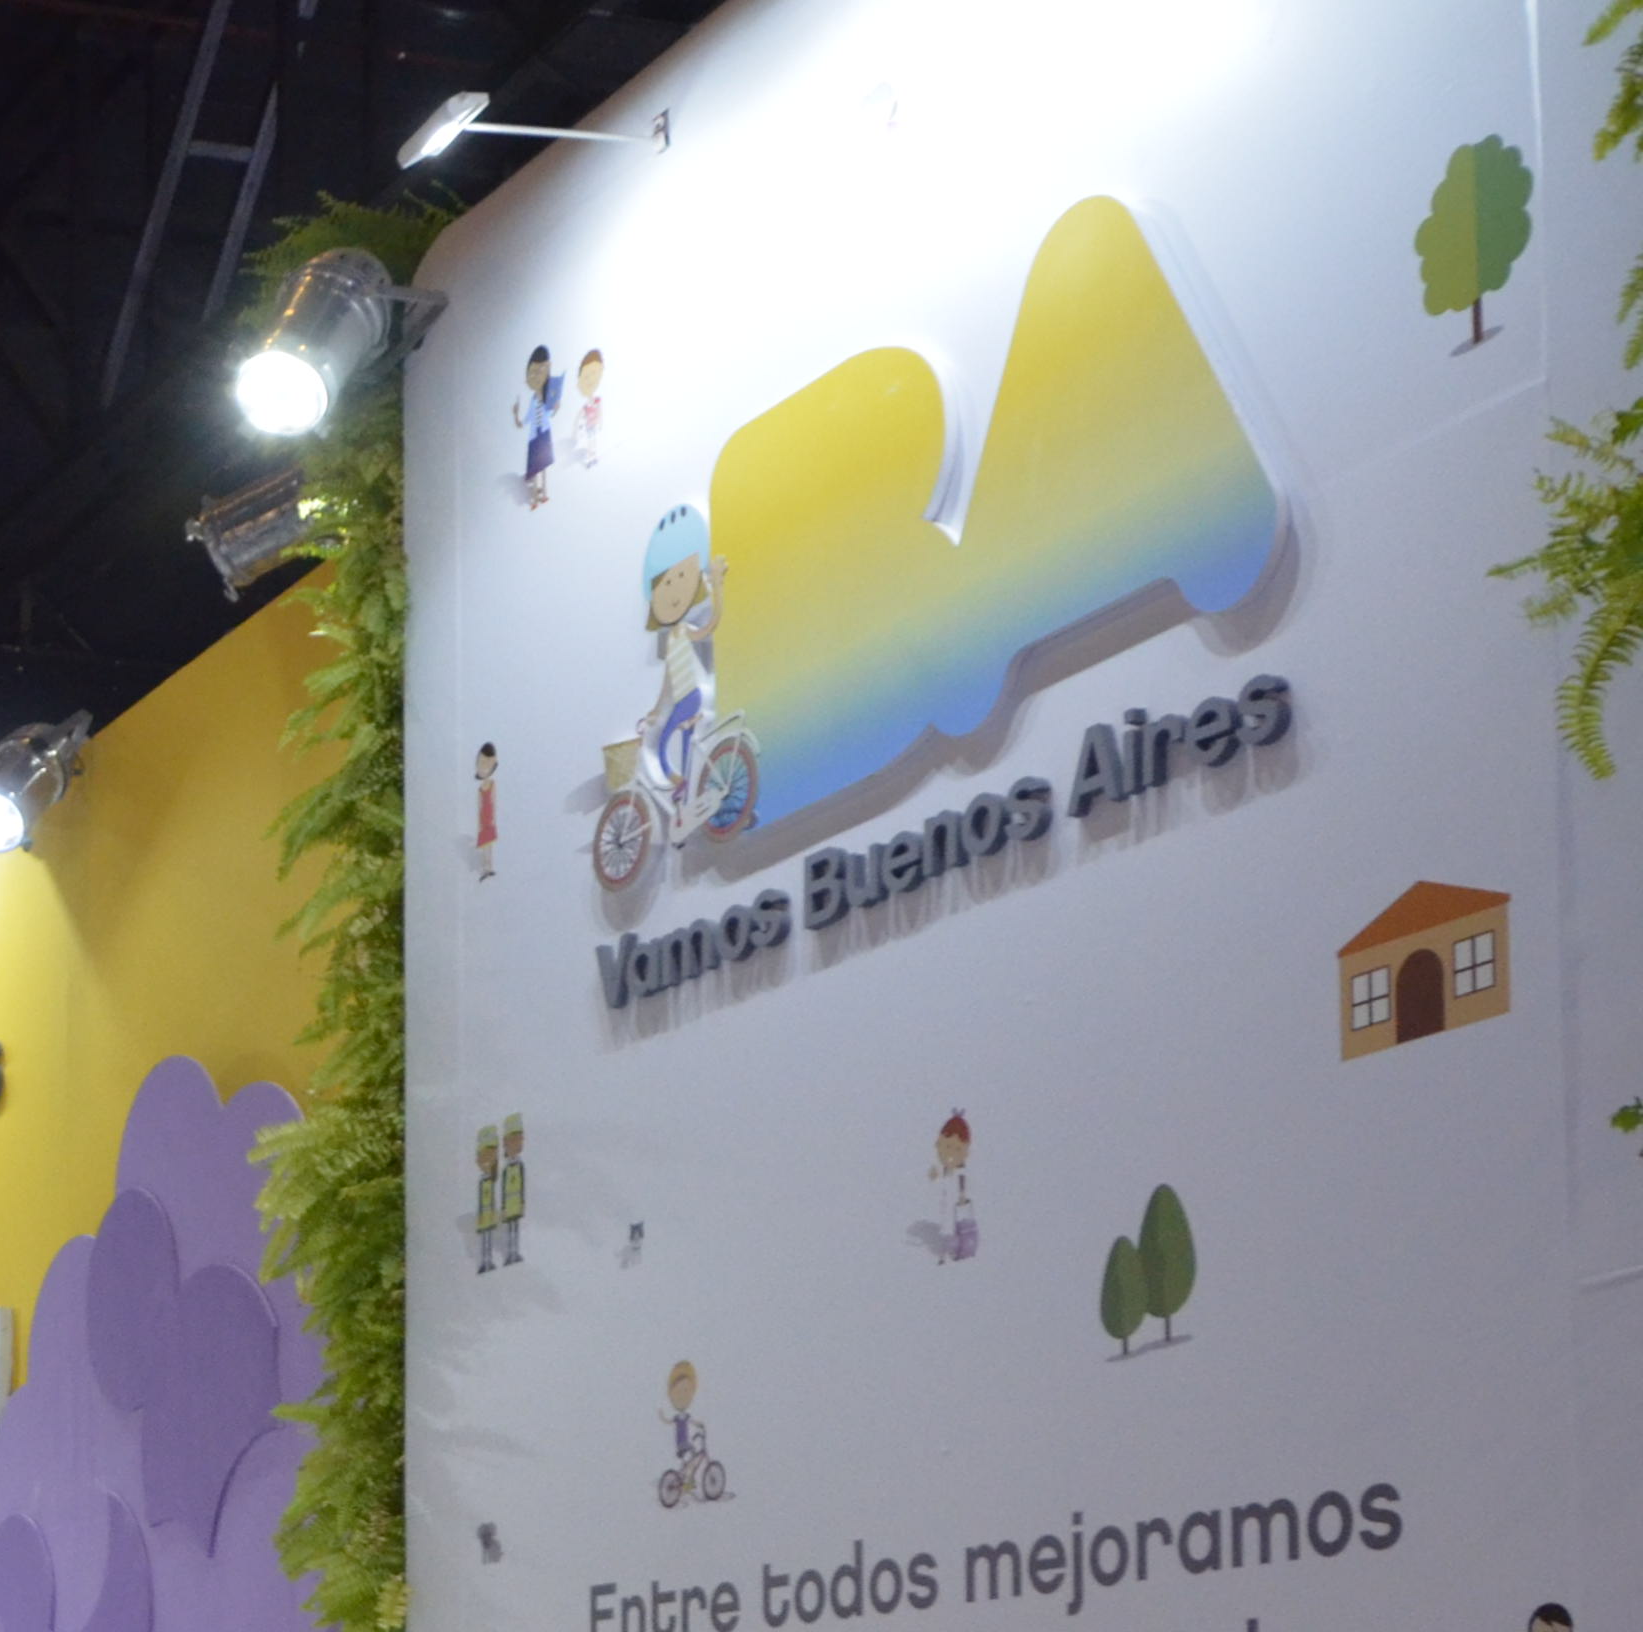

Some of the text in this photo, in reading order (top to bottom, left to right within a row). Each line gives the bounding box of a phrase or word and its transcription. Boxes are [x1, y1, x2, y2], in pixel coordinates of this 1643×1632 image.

[595, 672, 1292, 1010] Vamos Buenos Aires
[762, 1539, 939, 1629] todos
[965, 1482, 1403, 1616] mejoramos
